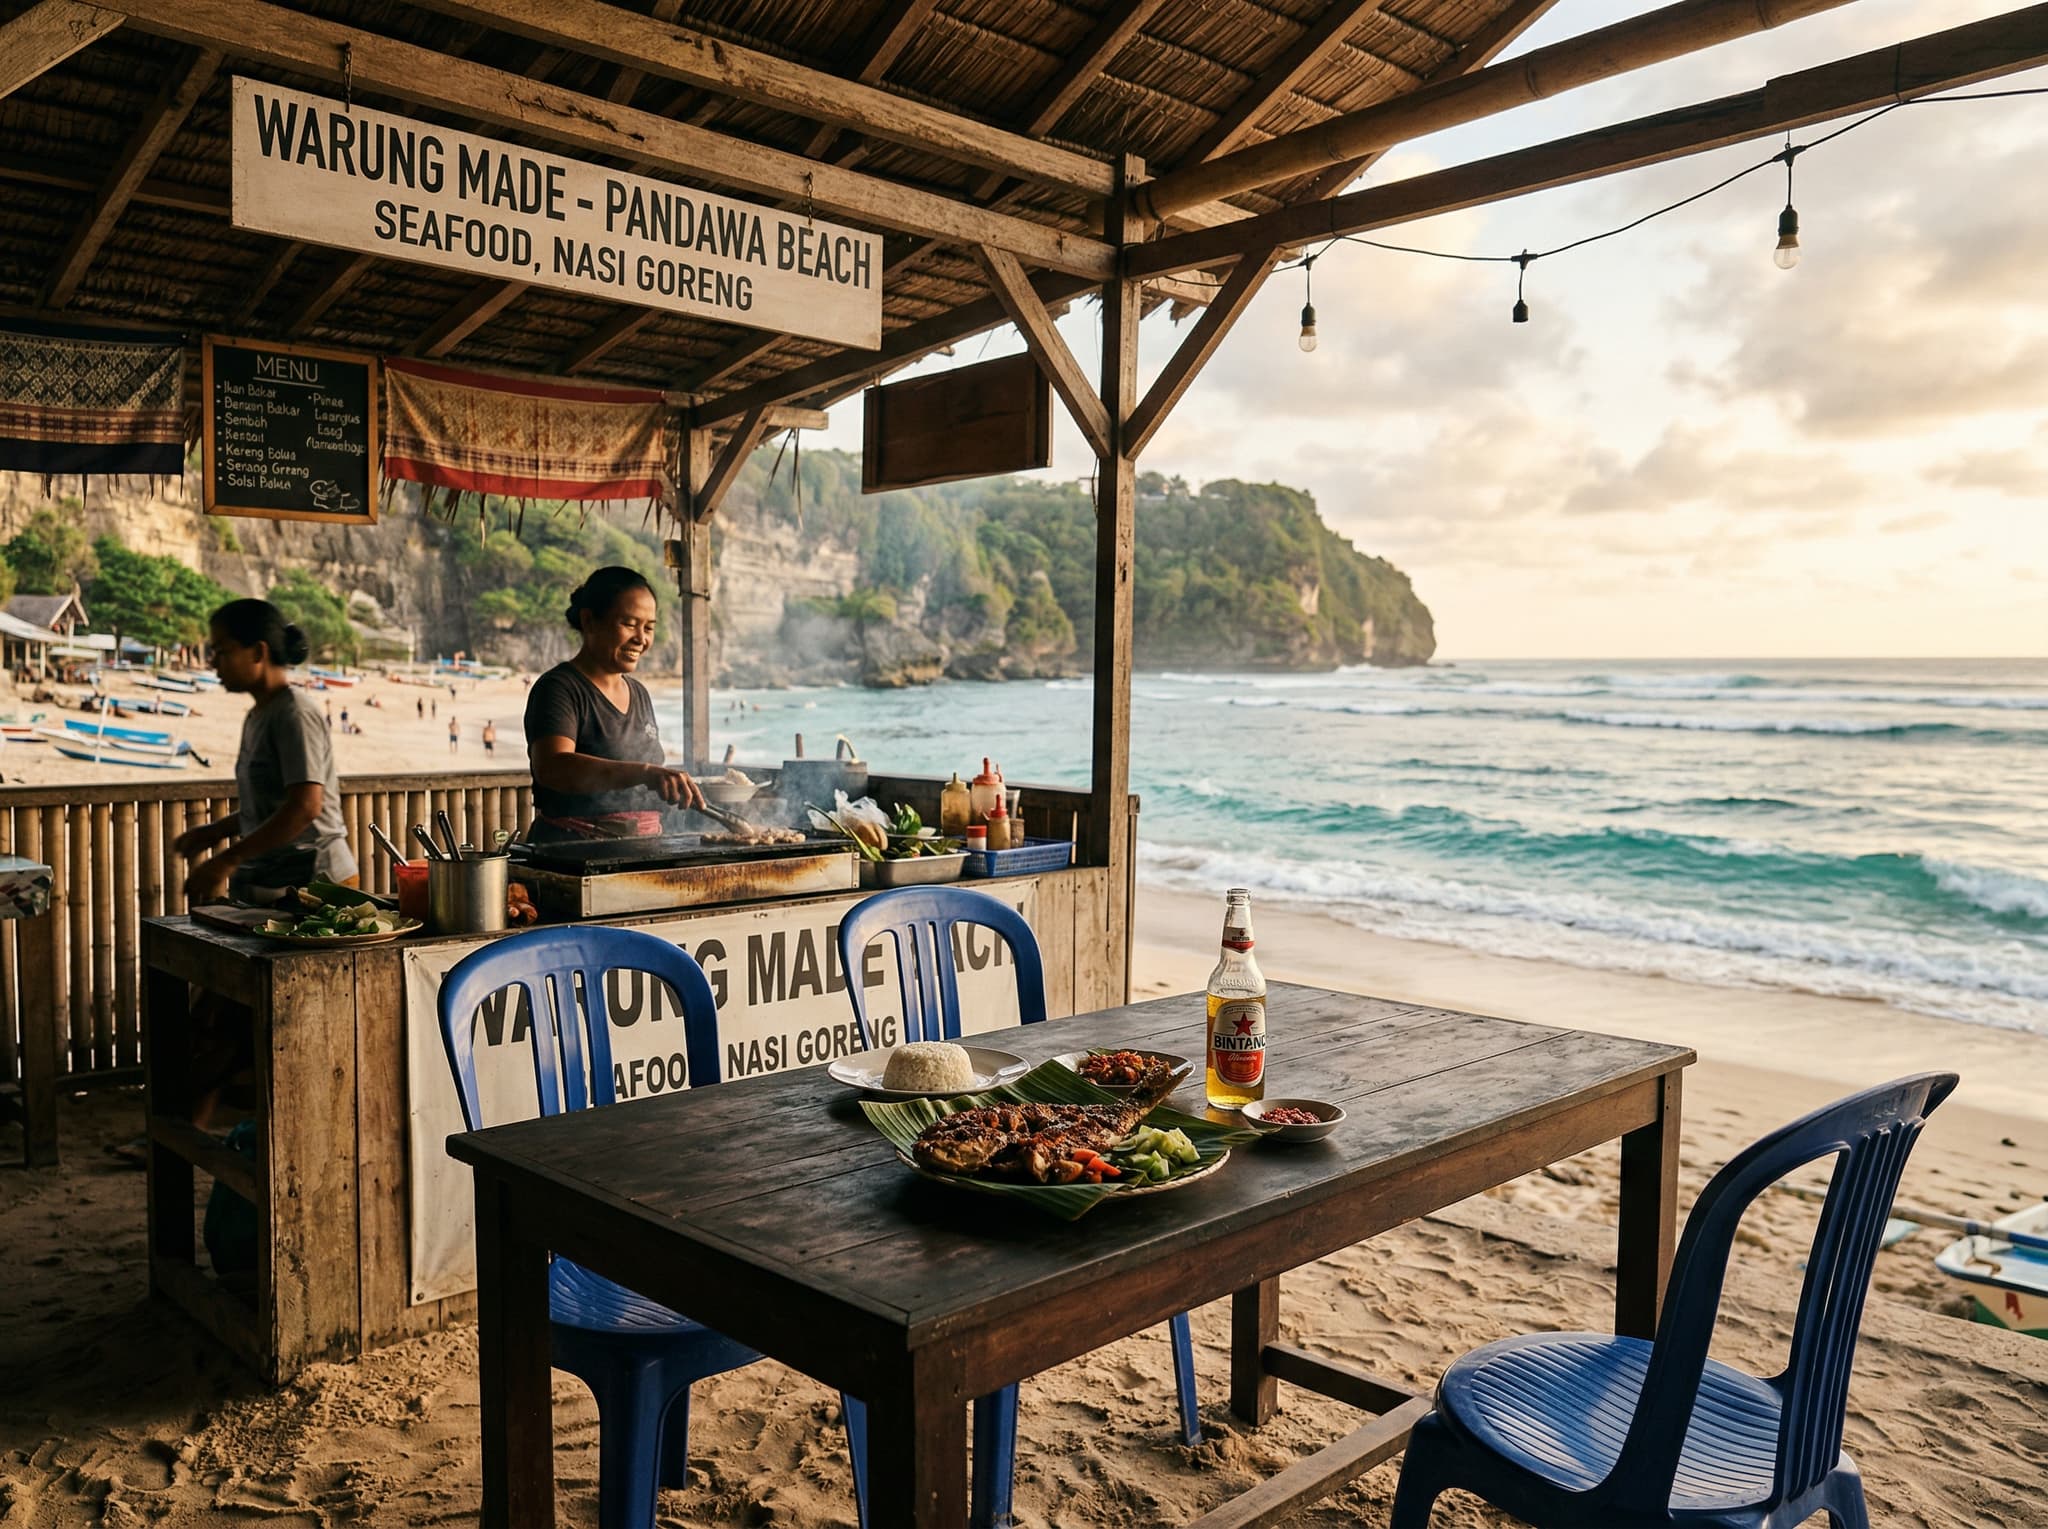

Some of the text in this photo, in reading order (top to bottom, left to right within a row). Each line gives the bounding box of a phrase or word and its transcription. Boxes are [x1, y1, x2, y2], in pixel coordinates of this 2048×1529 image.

[254, 95, 444, 194] WARUNG
[458, 144, 565, 221] MADE
[605, 179, 766, 267] PANDAWA
[778, 222, 870, 290] BEACH
[374, 200, 753, 311] SEAFOOD, NASI GORENG
[256, 354, 319, 383] MENU
[728, 1035, 787, 1079] NASI
[797, 1016, 897, 1065] GORENG
